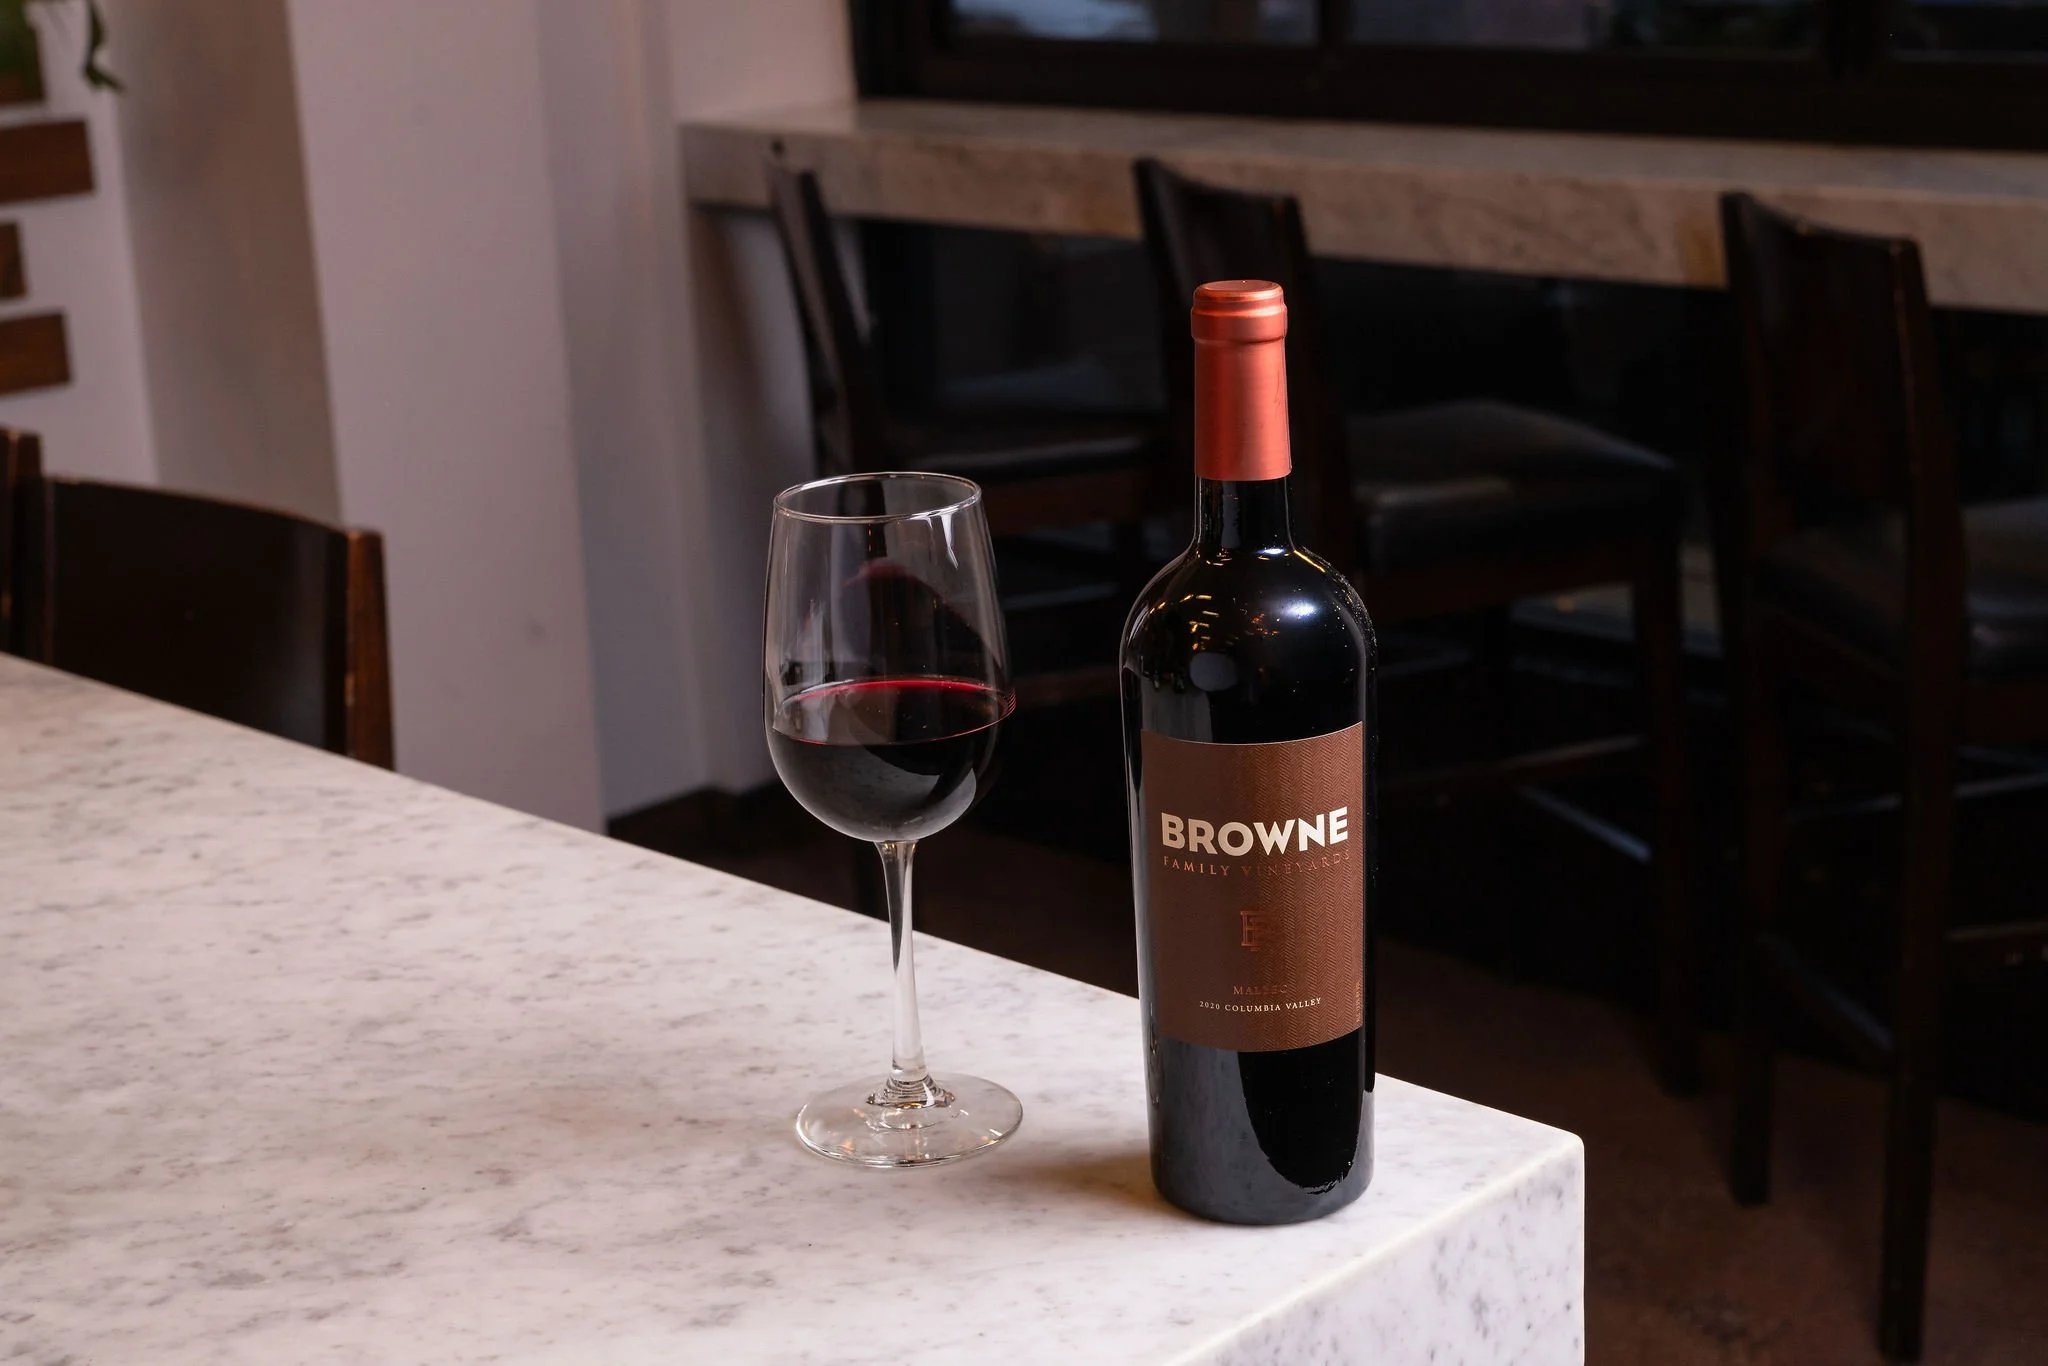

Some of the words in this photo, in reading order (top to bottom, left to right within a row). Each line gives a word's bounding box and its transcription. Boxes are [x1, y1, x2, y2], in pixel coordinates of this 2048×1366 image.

[1161, 806, 1349, 857] BROWNE
[1163, 855, 1230, 876] FAMILY
[1241, 850, 1350, 877] VINEYARDS
[1199, 1000, 1221, 1010] 2020
[1224, 1003, 1282, 1013] COLUMBIA
[1285, 997, 1322, 1010] VALLEY
